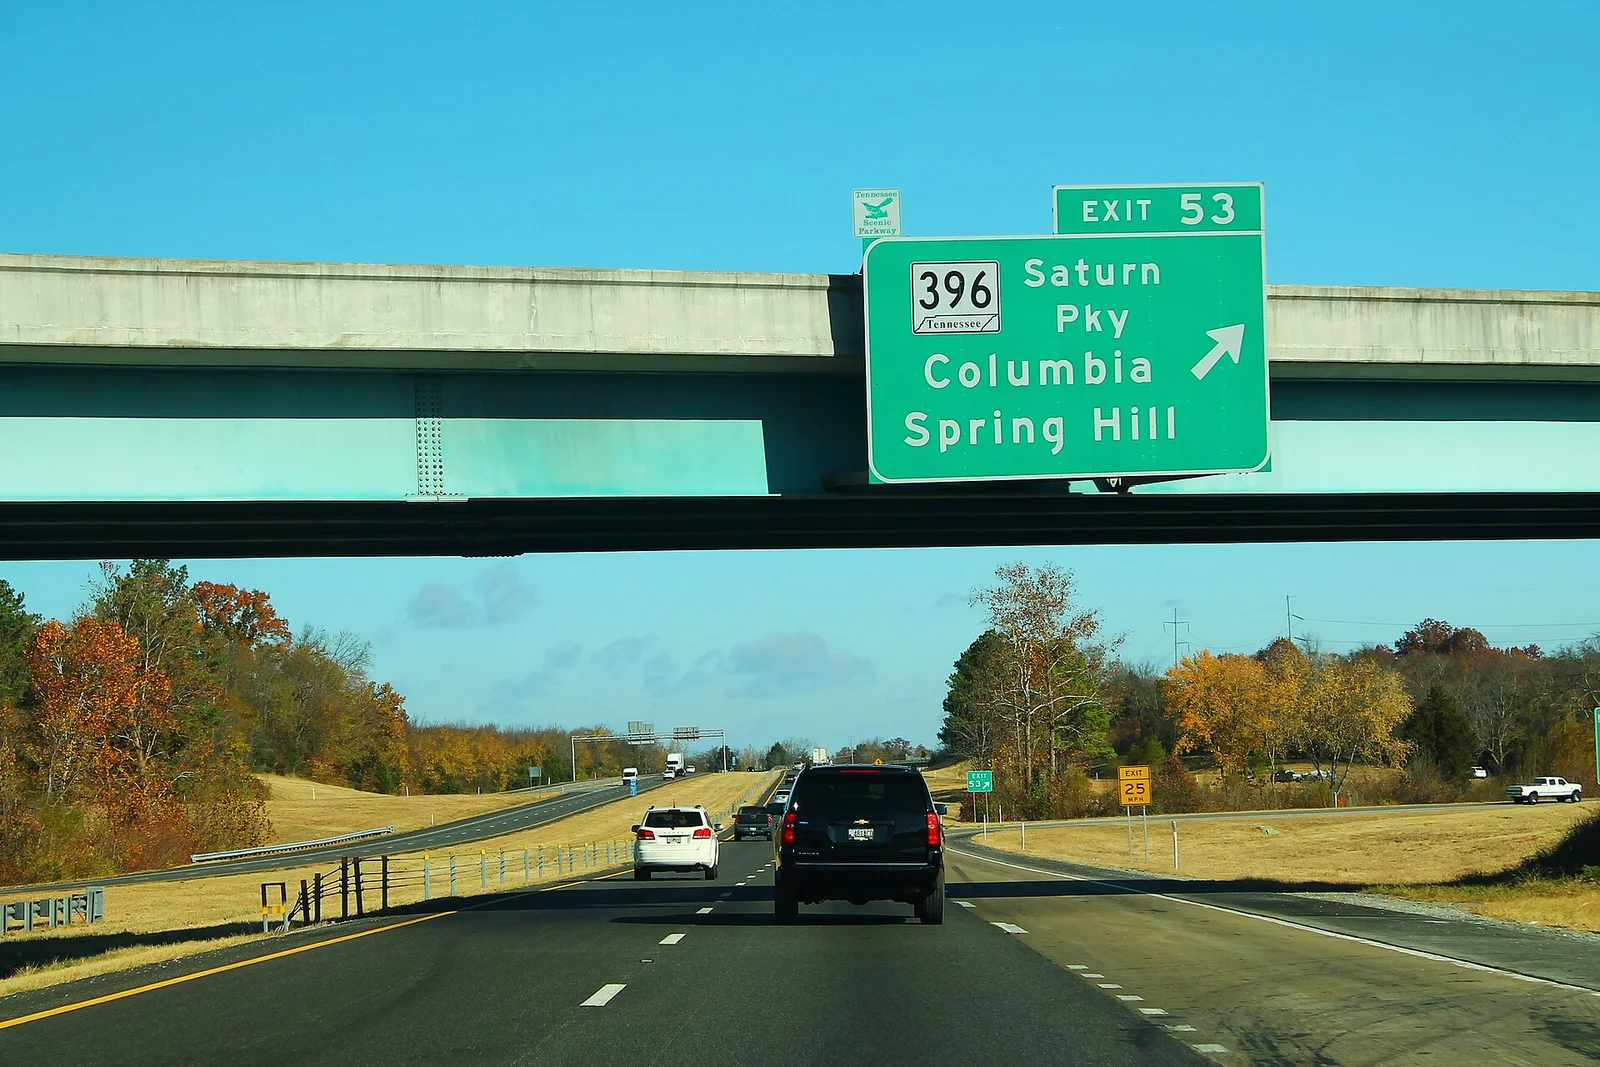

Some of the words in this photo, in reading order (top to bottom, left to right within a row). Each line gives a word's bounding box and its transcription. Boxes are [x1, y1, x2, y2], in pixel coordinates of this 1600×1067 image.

[1083, 199, 1151, 222] EXIT
[1180, 193, 1235, 226] 53
[859, 227, 897, 236] Parkway
[1024, 258, 1160, 288] Saturn
[919, 270, 992, 310] 396
[926, 319, 981, 329] Tennessee
[1057, 304, 1129, 339] Pky
[924, 350, 1152, 388] Columbia
[904, 410, 1064, 454] Spring
[1093, 405, 1176, 441] Hill
[969, 780, 981, 788] 53
[1125, 783, 1145, 795] 25
